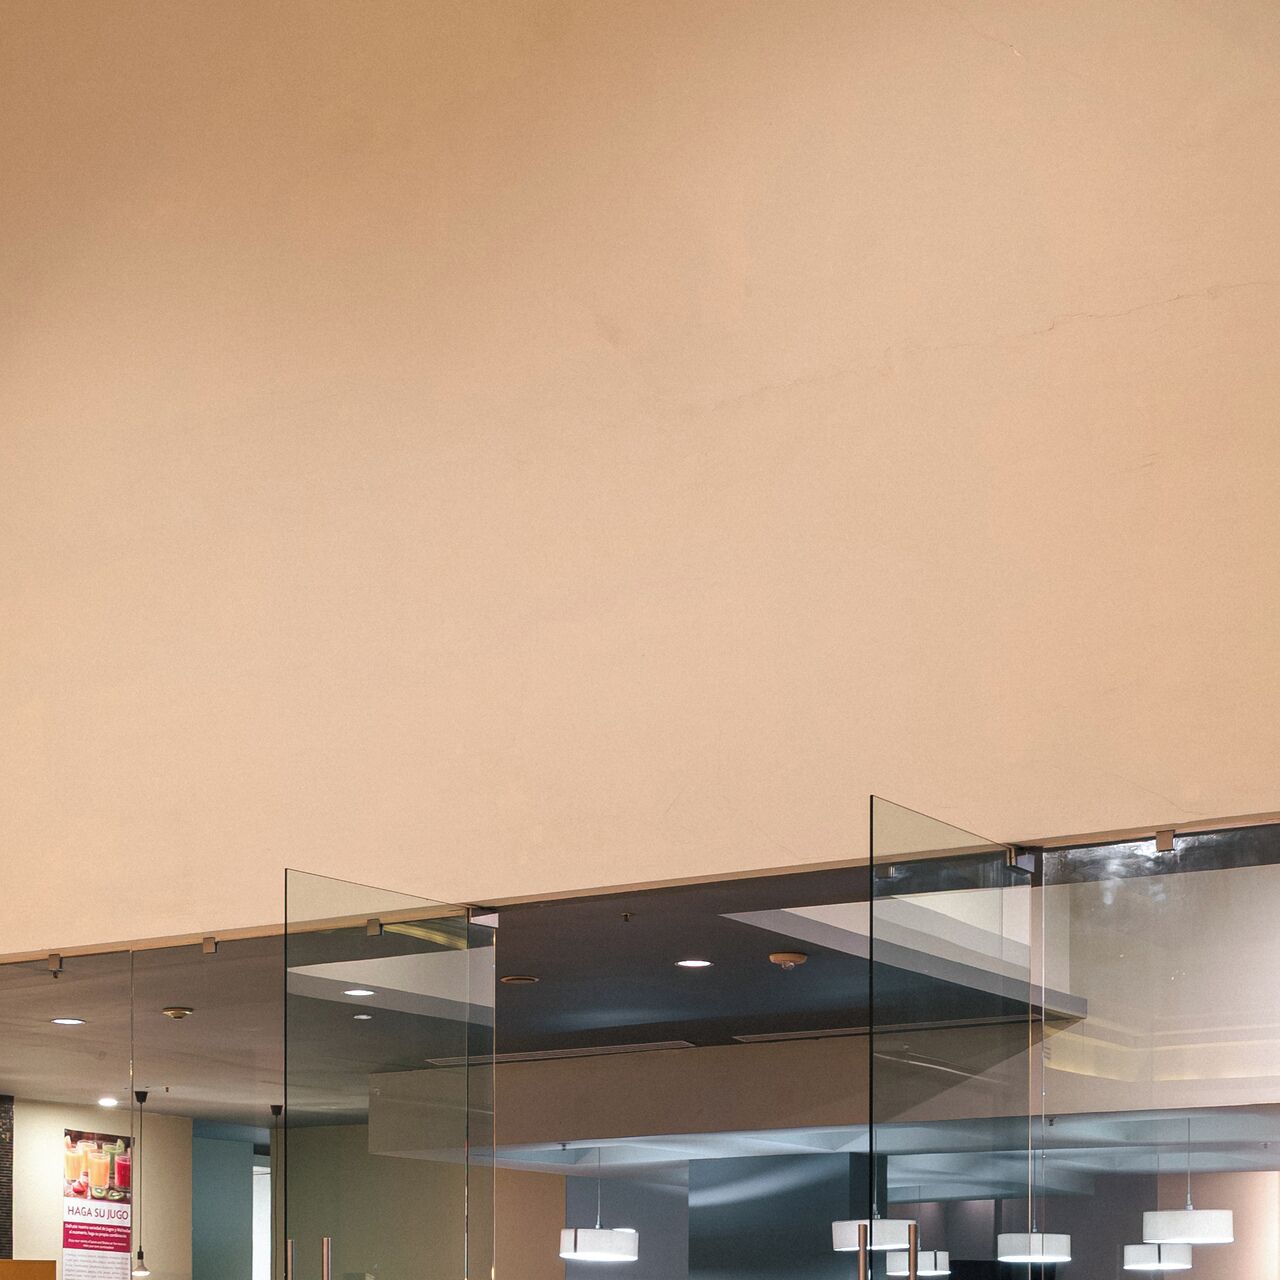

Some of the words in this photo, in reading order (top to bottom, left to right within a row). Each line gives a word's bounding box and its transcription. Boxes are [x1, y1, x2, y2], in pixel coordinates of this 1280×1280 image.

[68, 1206, 92, 1217] HAGA
[94, 1208, 105, 1217] SU
[107, 1209, 129, 1220] JUGO
